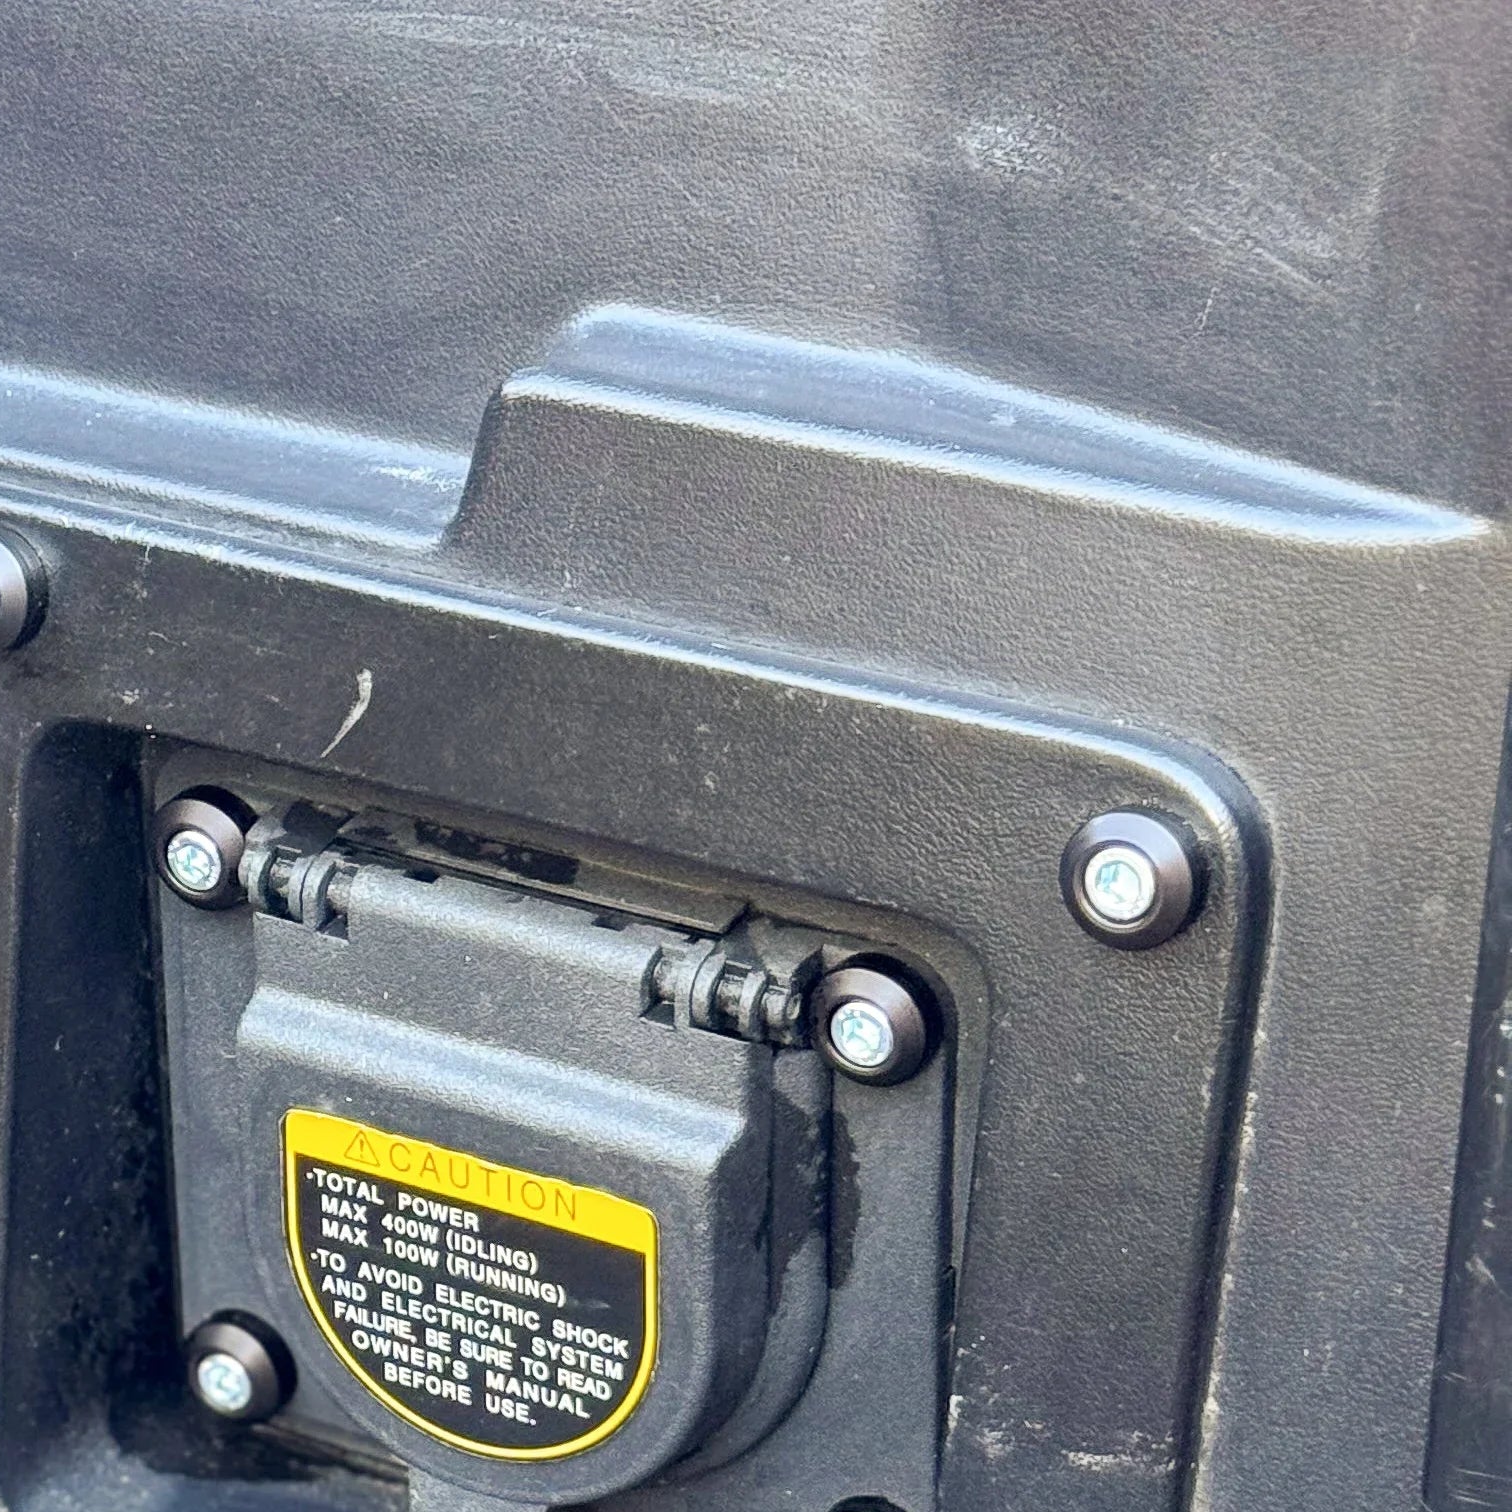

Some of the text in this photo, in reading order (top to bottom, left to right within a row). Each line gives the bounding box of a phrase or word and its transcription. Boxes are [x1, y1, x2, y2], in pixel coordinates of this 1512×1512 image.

[388, 1142, 577, 1222] CAUTION
[397, 1191, 480, 1233] POWER
[321, 1193, 539, 1276] MAX 400W (IDLING)
[321, 1217, 567, 1309] MAX 100W (RUNNING)
[321, 1274, 625, 1381] AND ELECTRICAL SYSTEM
[333, 1299, 613, 1401] FAILURE, BE SURE TO READ
[357, 1261, 424, 1296] AVOID
[435, 1282, 541, 1332] ELECTRIC
[551, 1318, 630, 1360] SHOCK
[351, 1329, 592, 1420] OWNER'S MANUAL
[383, 1361, 537, 1426] BEFORE USE.
